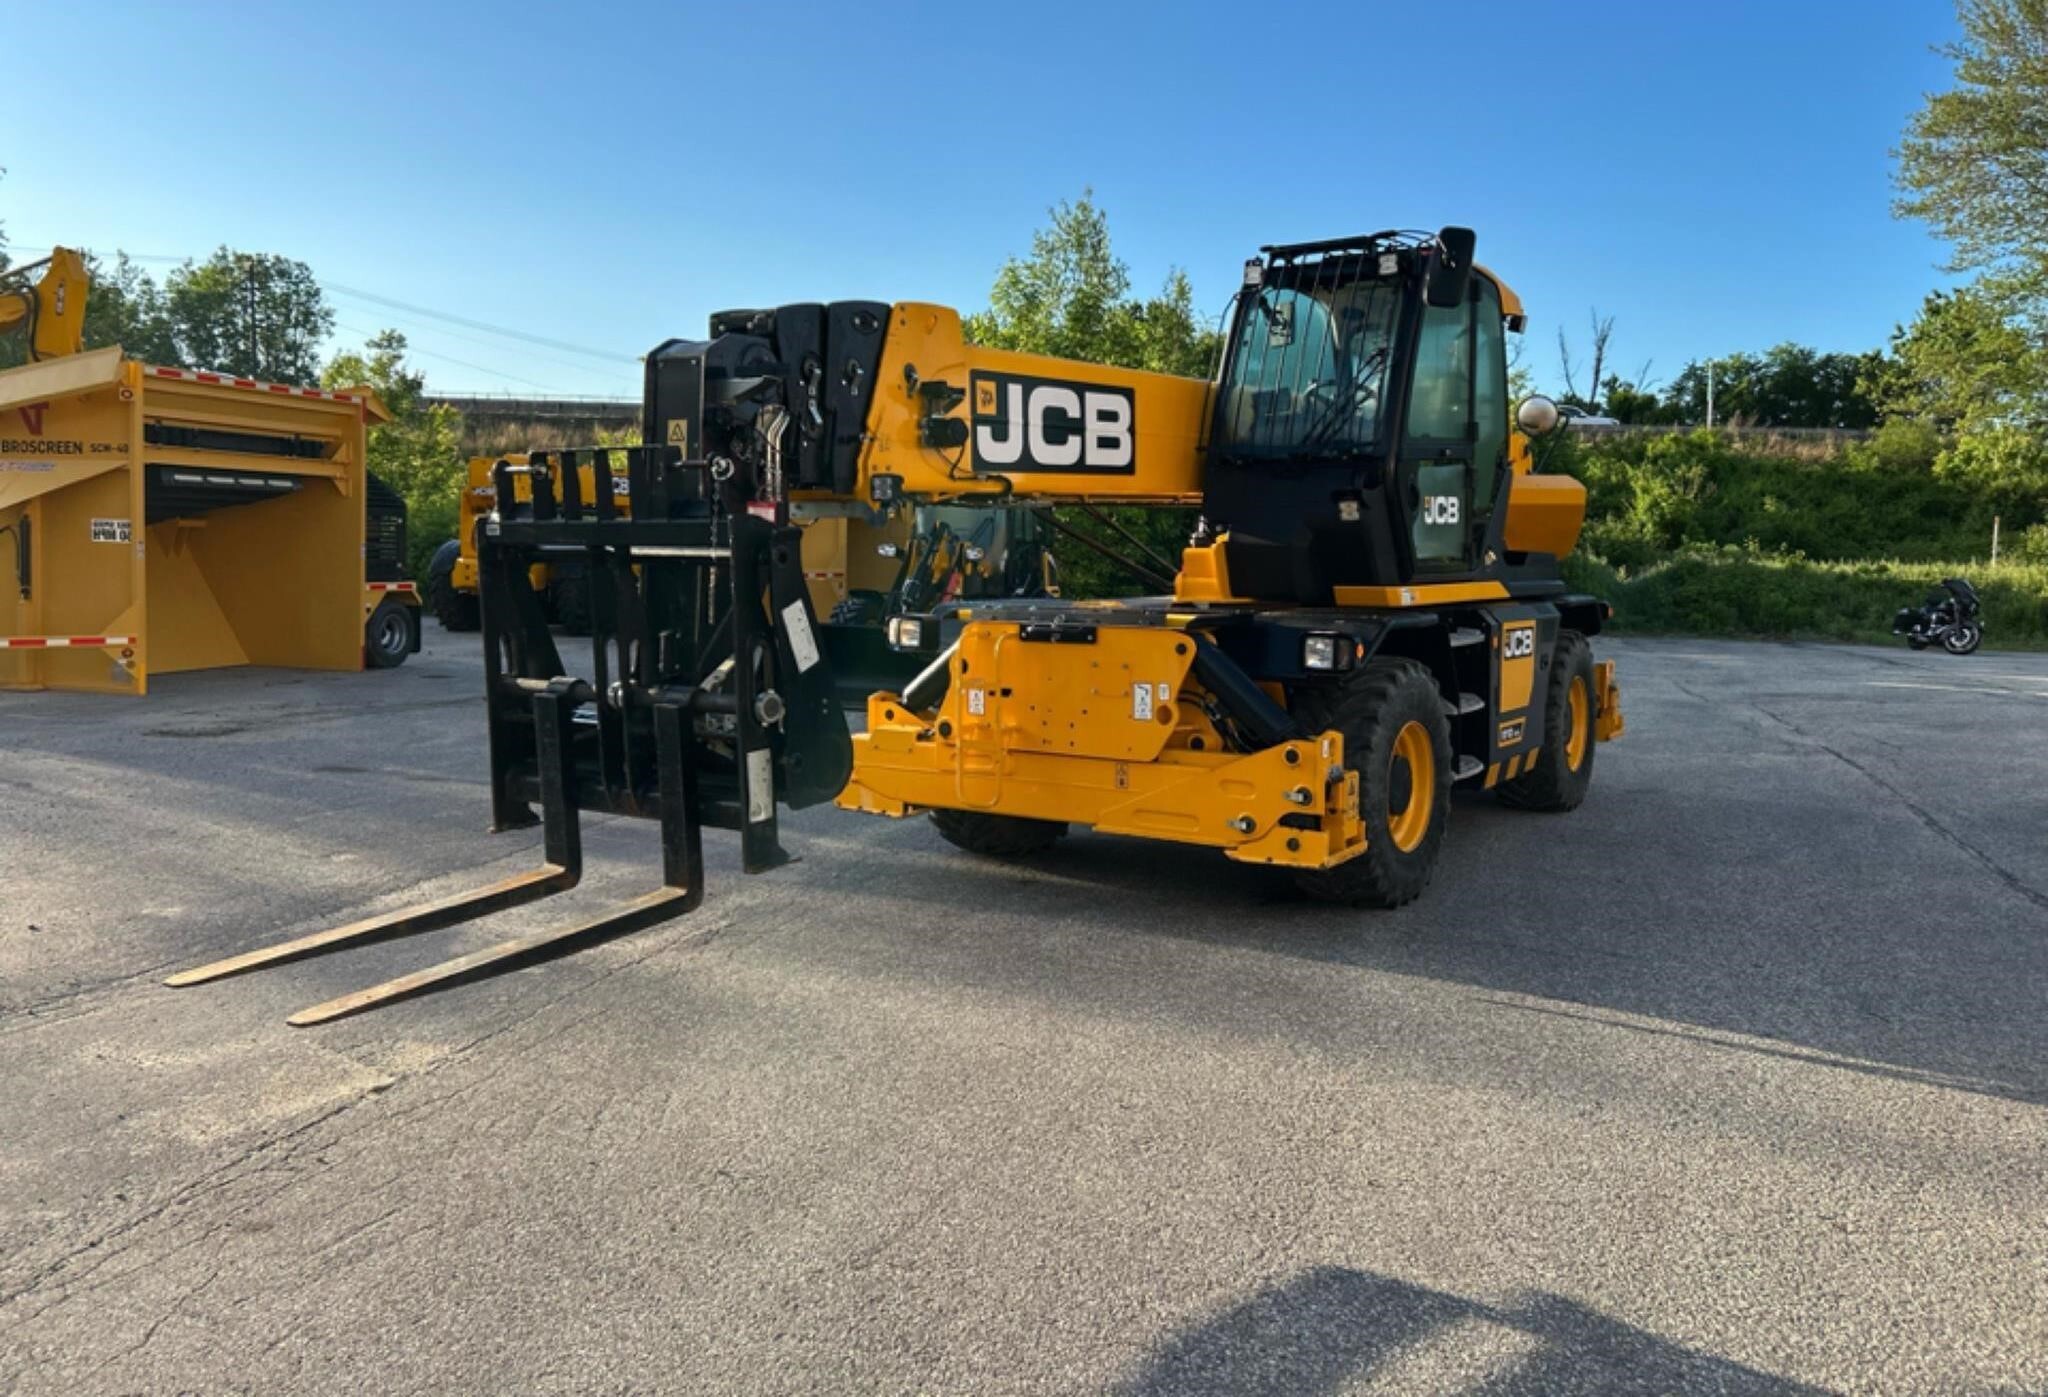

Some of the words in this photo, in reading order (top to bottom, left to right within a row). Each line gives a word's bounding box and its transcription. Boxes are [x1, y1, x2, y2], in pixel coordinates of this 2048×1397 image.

[976, 383, 1132, 467] JCB
[1424, 496, 1460, 525] JCB
[1503, 628, 1533, 658] JCB
